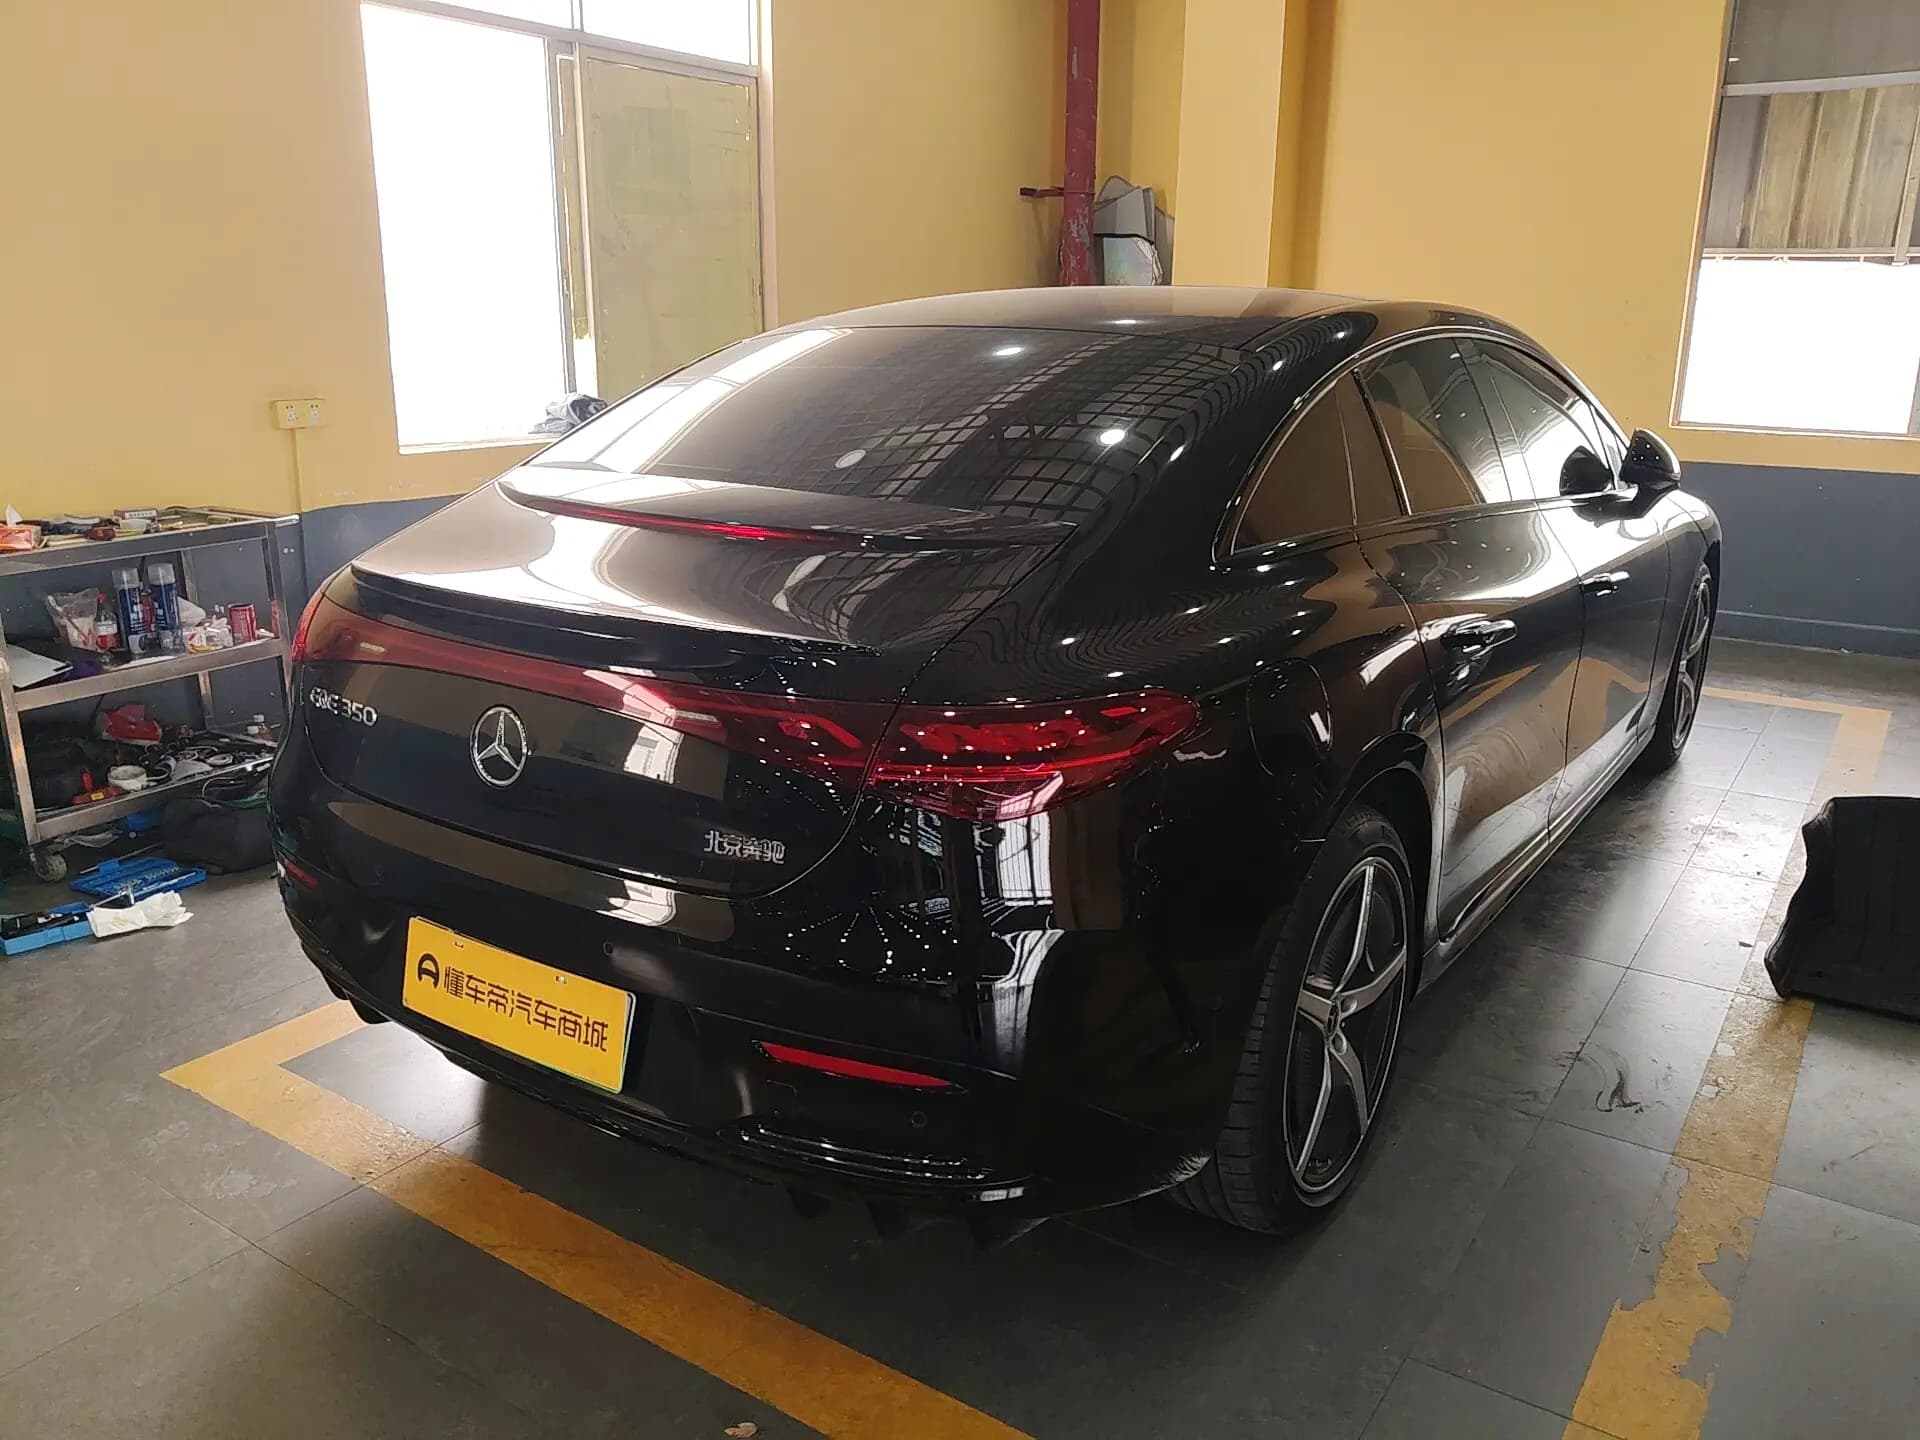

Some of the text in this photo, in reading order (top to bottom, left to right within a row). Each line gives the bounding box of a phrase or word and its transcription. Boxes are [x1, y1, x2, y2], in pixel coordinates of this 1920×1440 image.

[703, 829, 786, 865] 北京奔驰
[443, 965, 609, 1052] 懂车帝汽车商城
